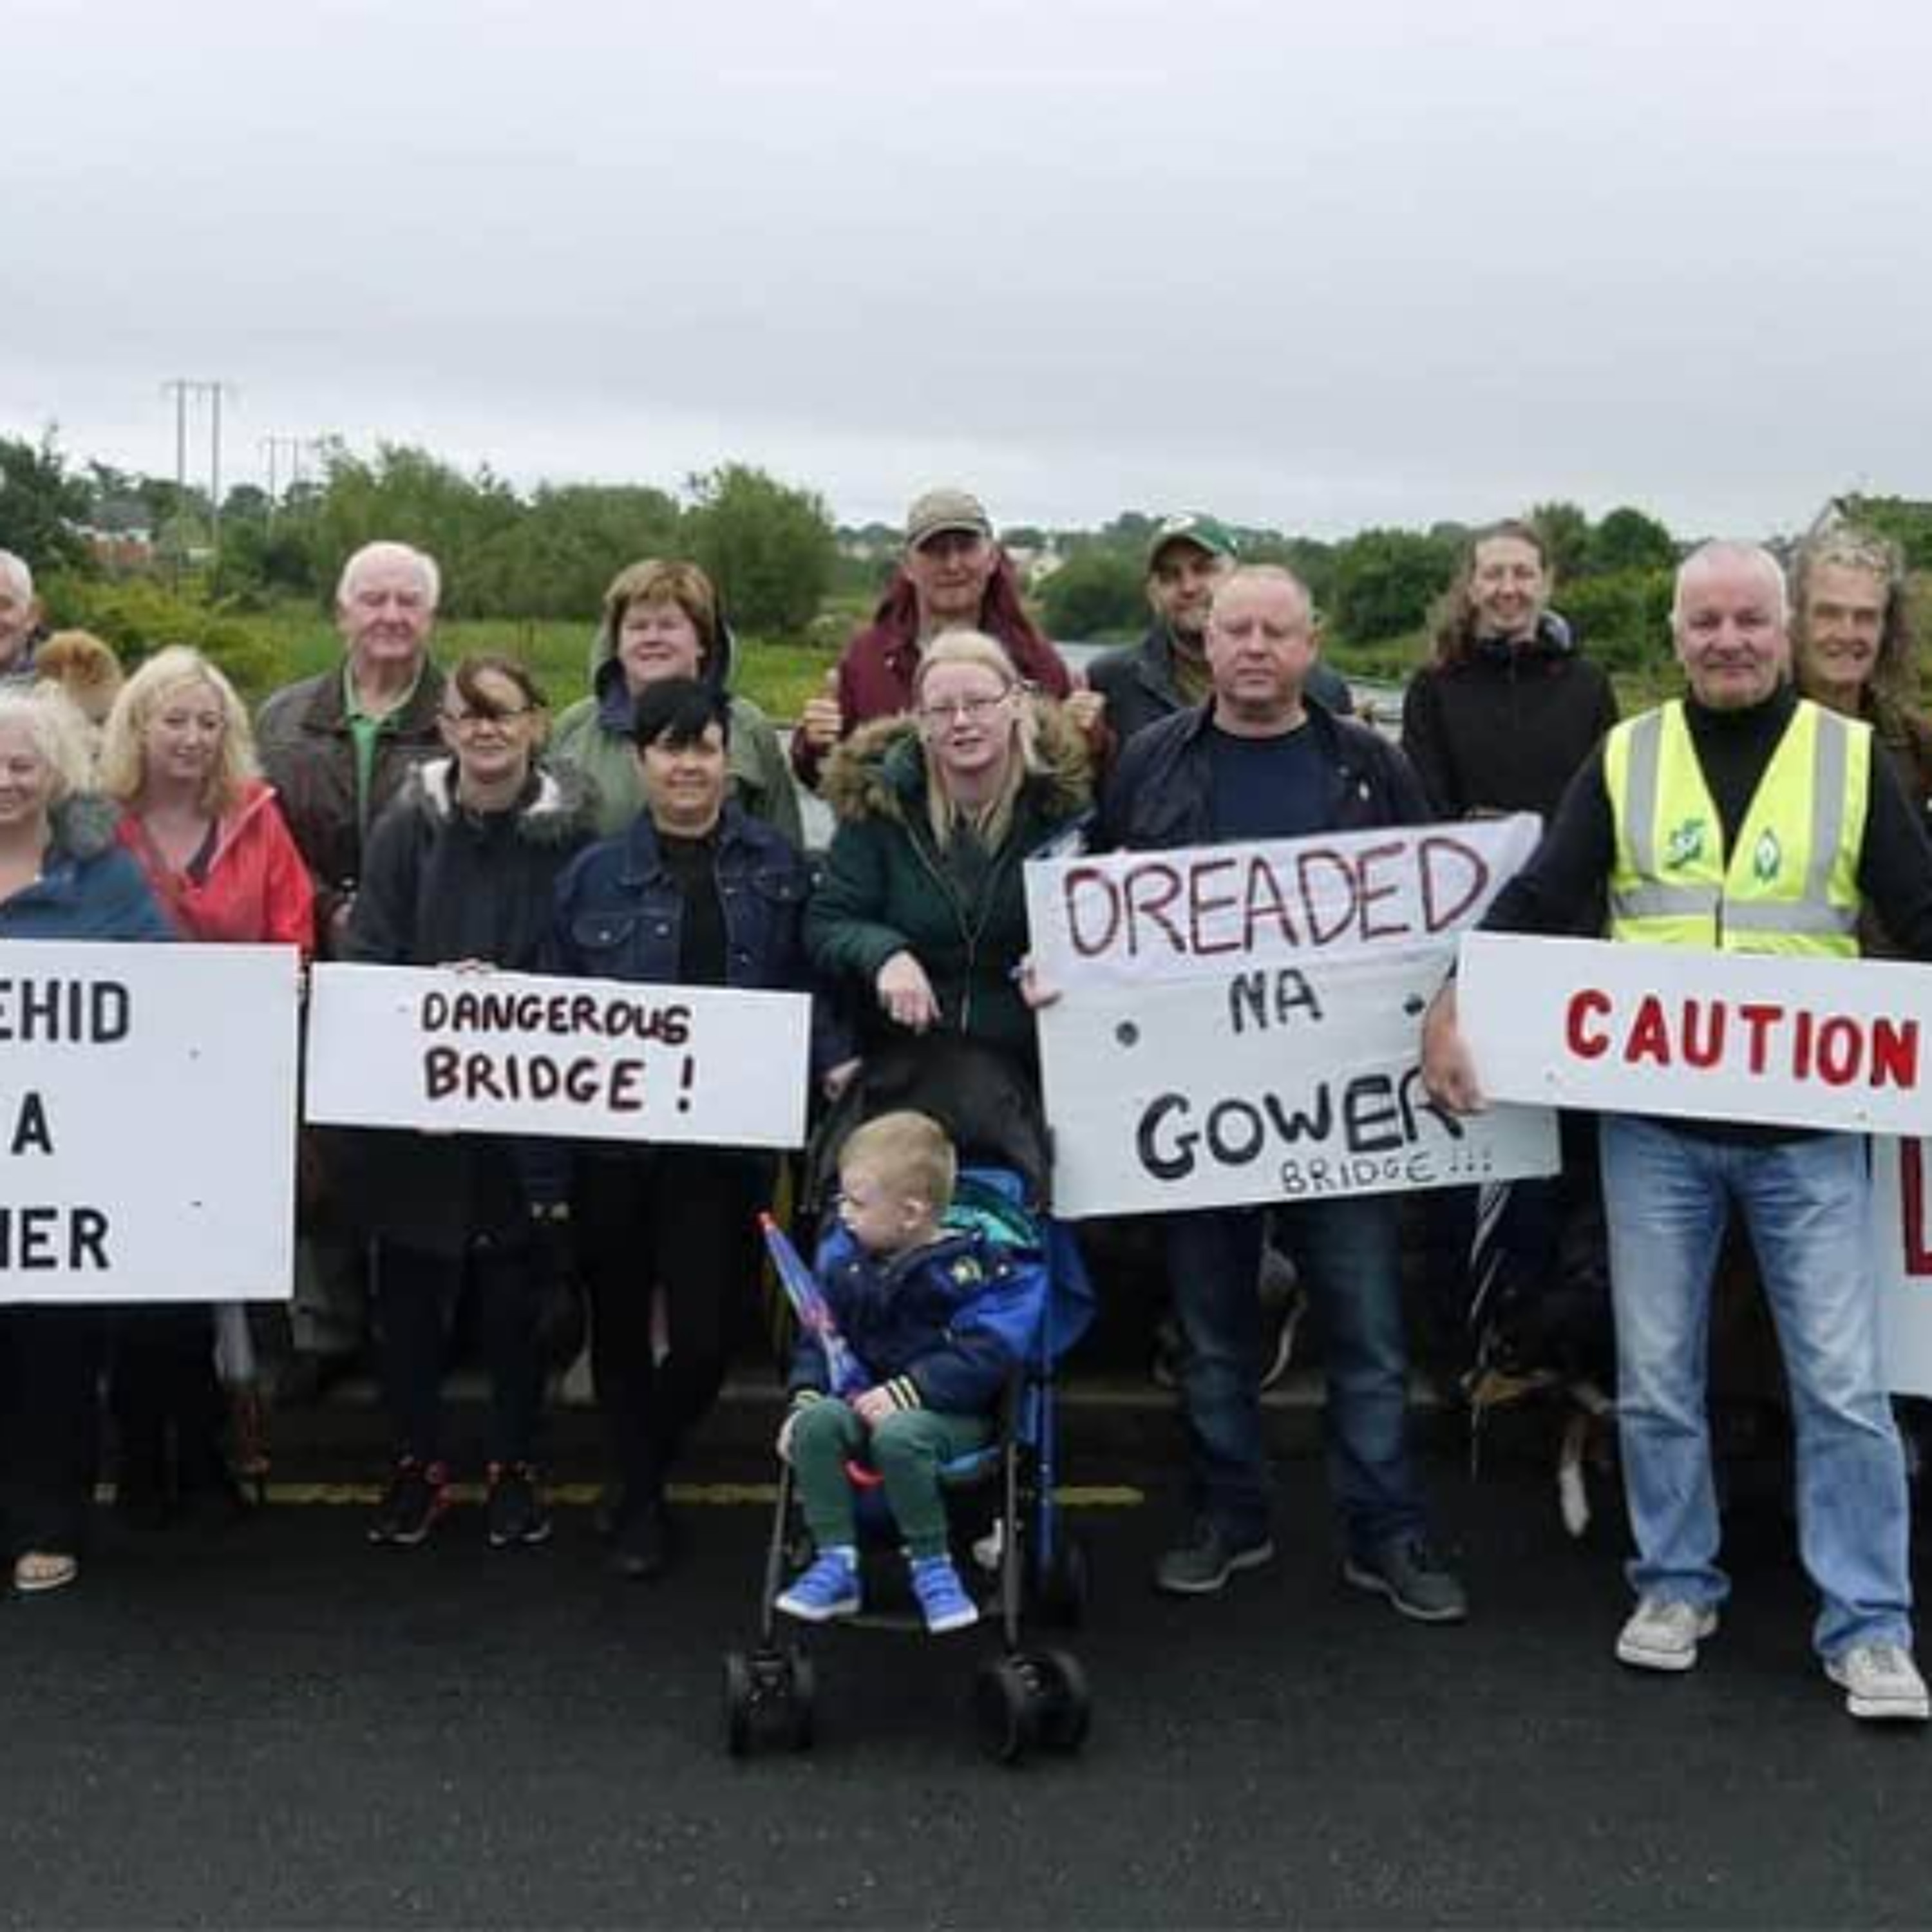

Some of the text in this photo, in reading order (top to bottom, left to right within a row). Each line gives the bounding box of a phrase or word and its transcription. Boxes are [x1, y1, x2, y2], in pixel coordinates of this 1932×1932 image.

[422, 992, 691, 1045] DANGEROUS
[1229, 969, 1323, 1034] NA
[1566, 989, 1918, 1088] CAUTION
[425, 1046, 643, 1111] BRIDGE
[10, 1092, 53, 1155] A
